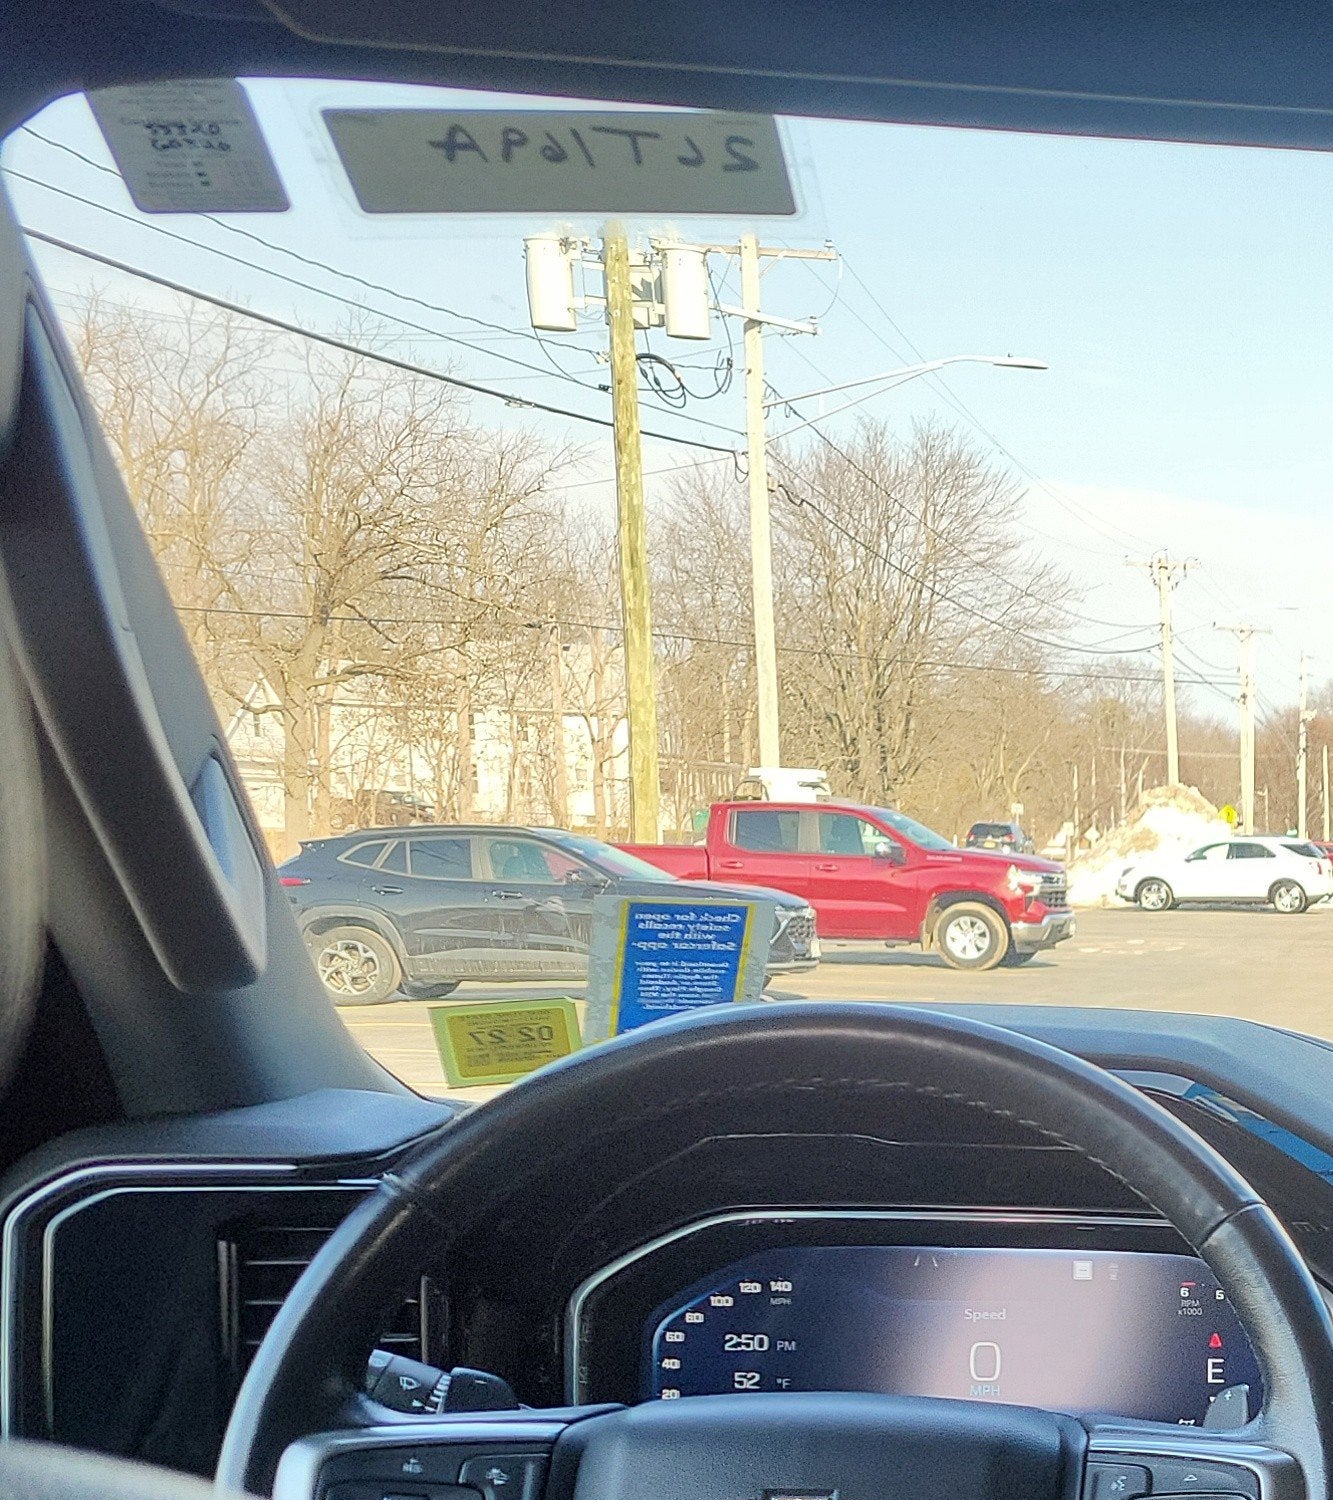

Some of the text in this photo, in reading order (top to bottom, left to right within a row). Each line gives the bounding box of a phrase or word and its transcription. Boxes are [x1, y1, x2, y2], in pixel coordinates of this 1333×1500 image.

[738, 1280, 762, 1293] 120
[769, 1280, 793, 1292] 140
[1179, 1286, 1190, 1298] 6
[709, 1295, 735, 1307] 100
[1179, 1299, 1200, 1308] RPM
[963, 1308, 1008, 1323] Speed
[1177, 1307, 1203, 1316] x1000
[723, 1333, 796, 1351] 2:50 PM
[661, 1358, 682, 1370] 40
[969, 1340, 1002, 1382] 0
[1206, 1357, 1226, 1385] E
[733, 1371, 762, 1390] 52
[661, 1388, 681, 1400] 20
[969, 1384, 1001, 1397] MPH
